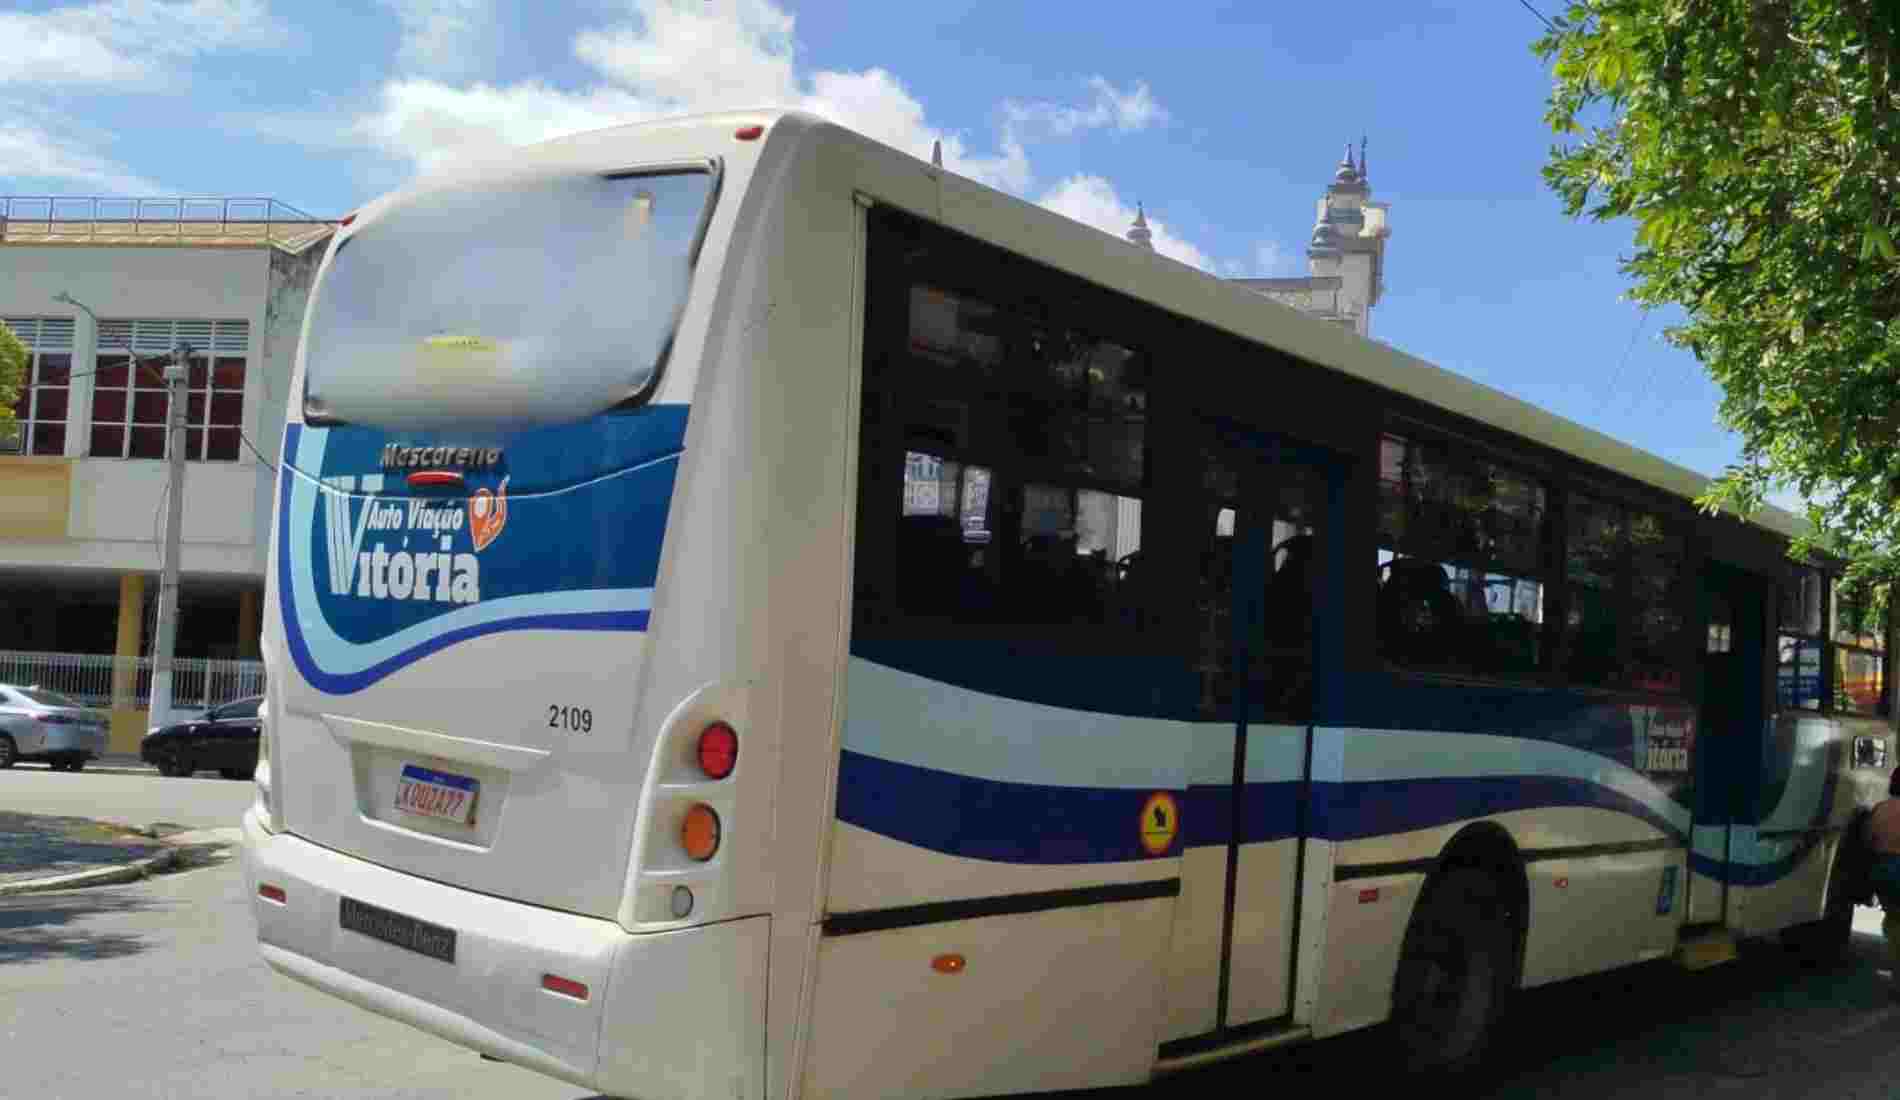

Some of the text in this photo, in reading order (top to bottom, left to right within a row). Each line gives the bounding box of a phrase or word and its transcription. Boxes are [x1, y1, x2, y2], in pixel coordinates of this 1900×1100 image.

[320, 473, 480, 603] Vitória
[367, 499, 464, 538] Auto Viação
[549, 704, 592, 732] 2109
